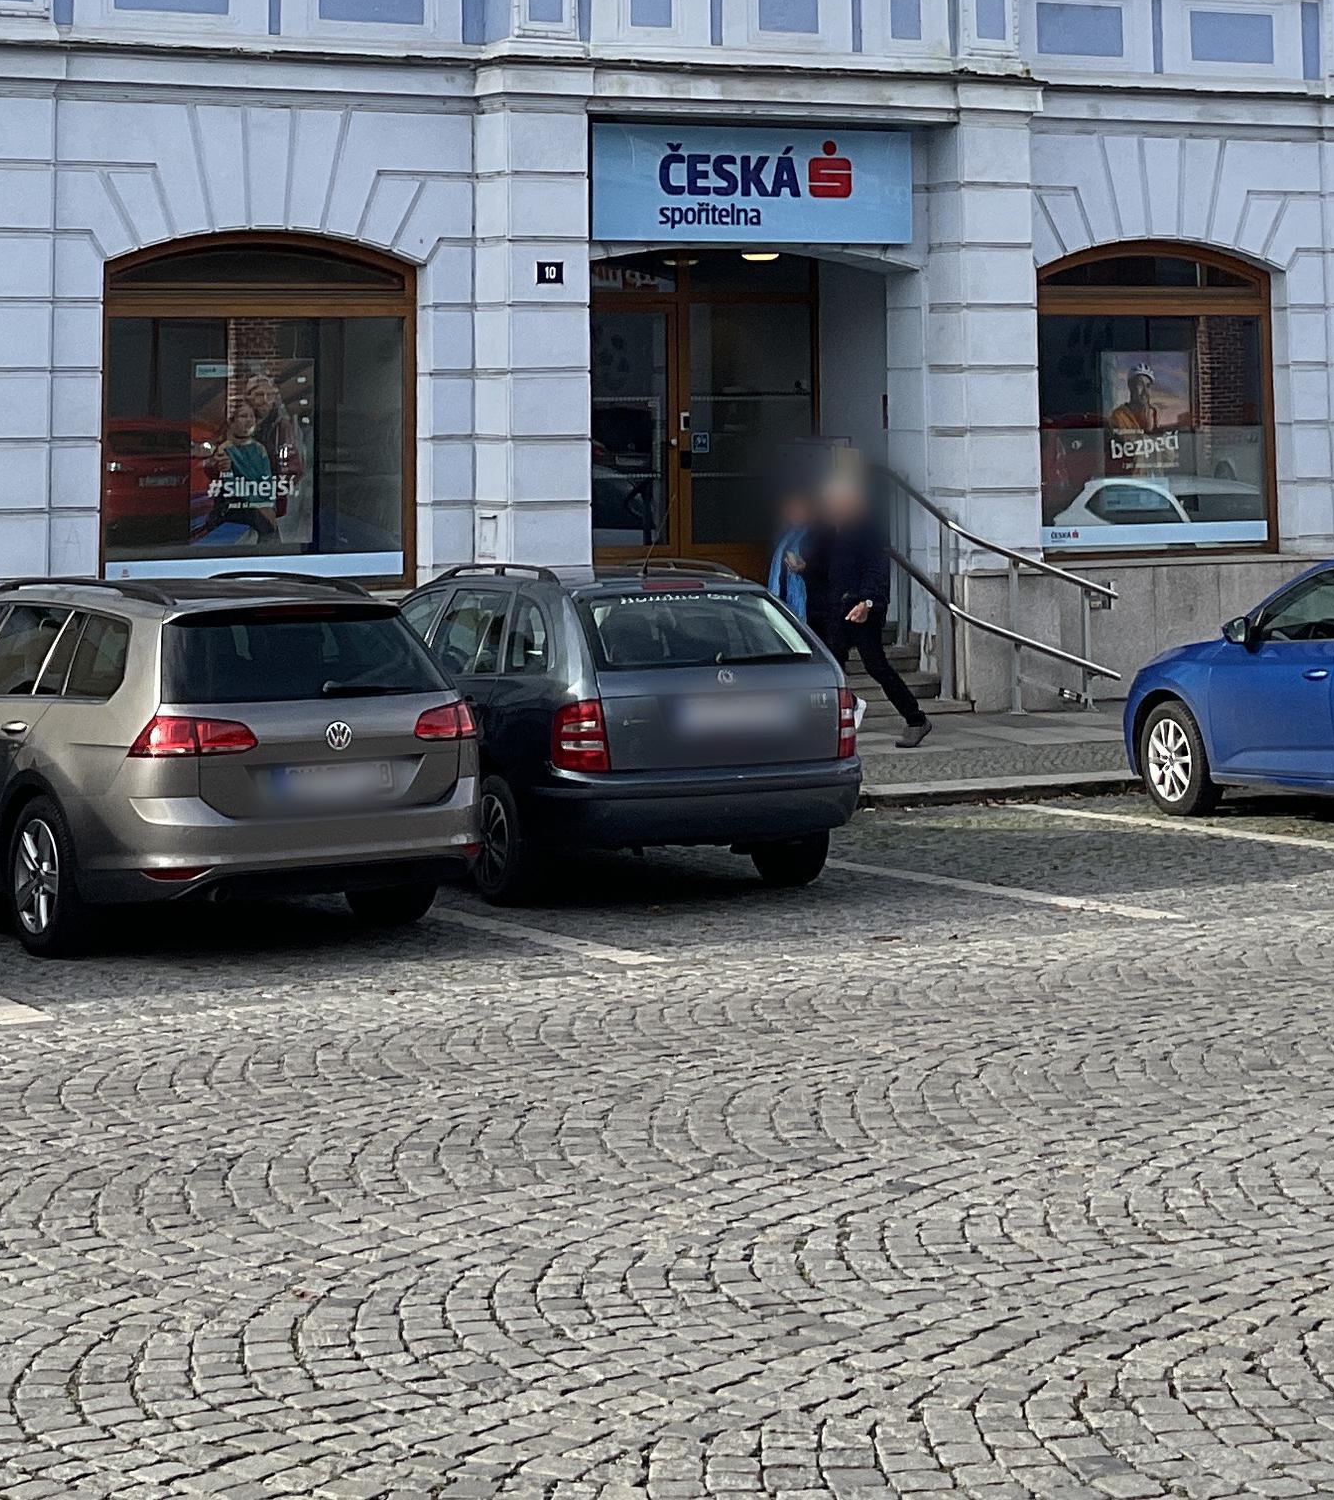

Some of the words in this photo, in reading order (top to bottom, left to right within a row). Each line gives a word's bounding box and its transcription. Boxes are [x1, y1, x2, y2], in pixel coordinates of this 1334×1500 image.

[659, 142, 802, 198] ČESKÁ
[658, 201, 762, 230] spořitelna
[544, 266, 557, 280] 10
[1110, 430, 1180, 460] bezpečí
[207, 475, 300, 500] #silnější,
